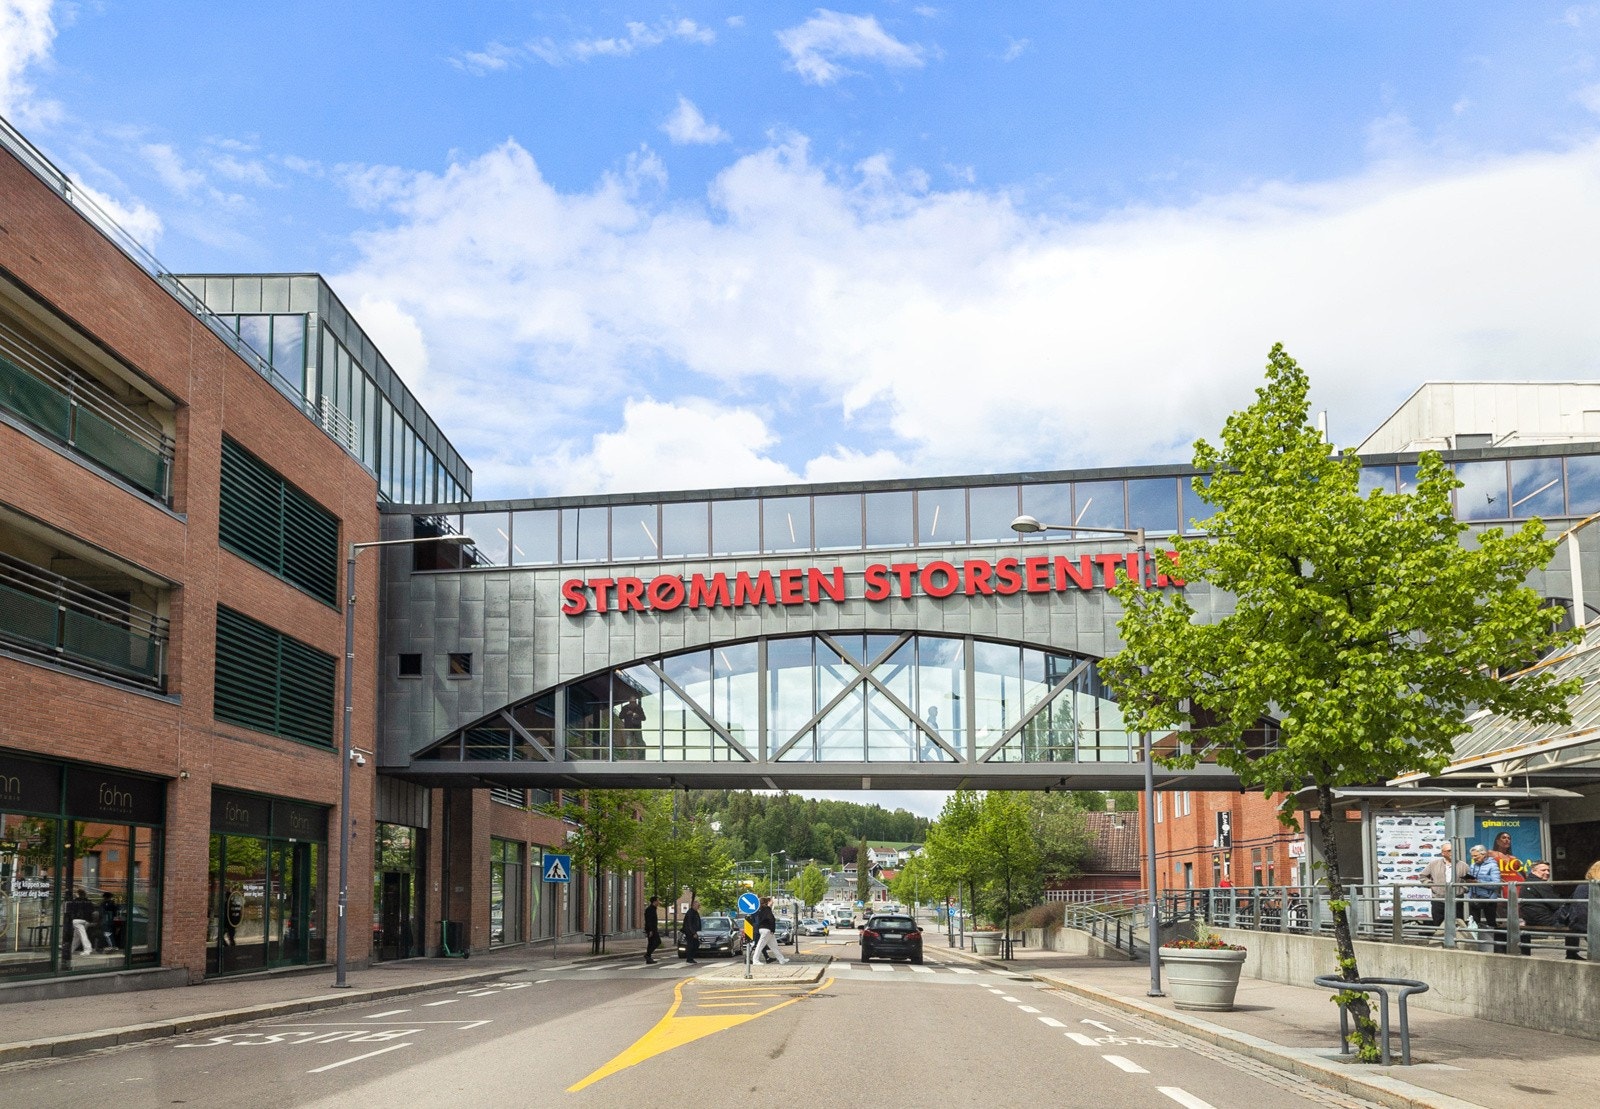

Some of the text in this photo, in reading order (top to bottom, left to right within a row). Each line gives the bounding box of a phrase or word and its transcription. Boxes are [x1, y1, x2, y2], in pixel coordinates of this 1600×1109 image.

[561, 566, 845, 615] STRØMMEN
[99, 782, 132, 808] föhn
[173, 1029, 425, 1048] BUSS
